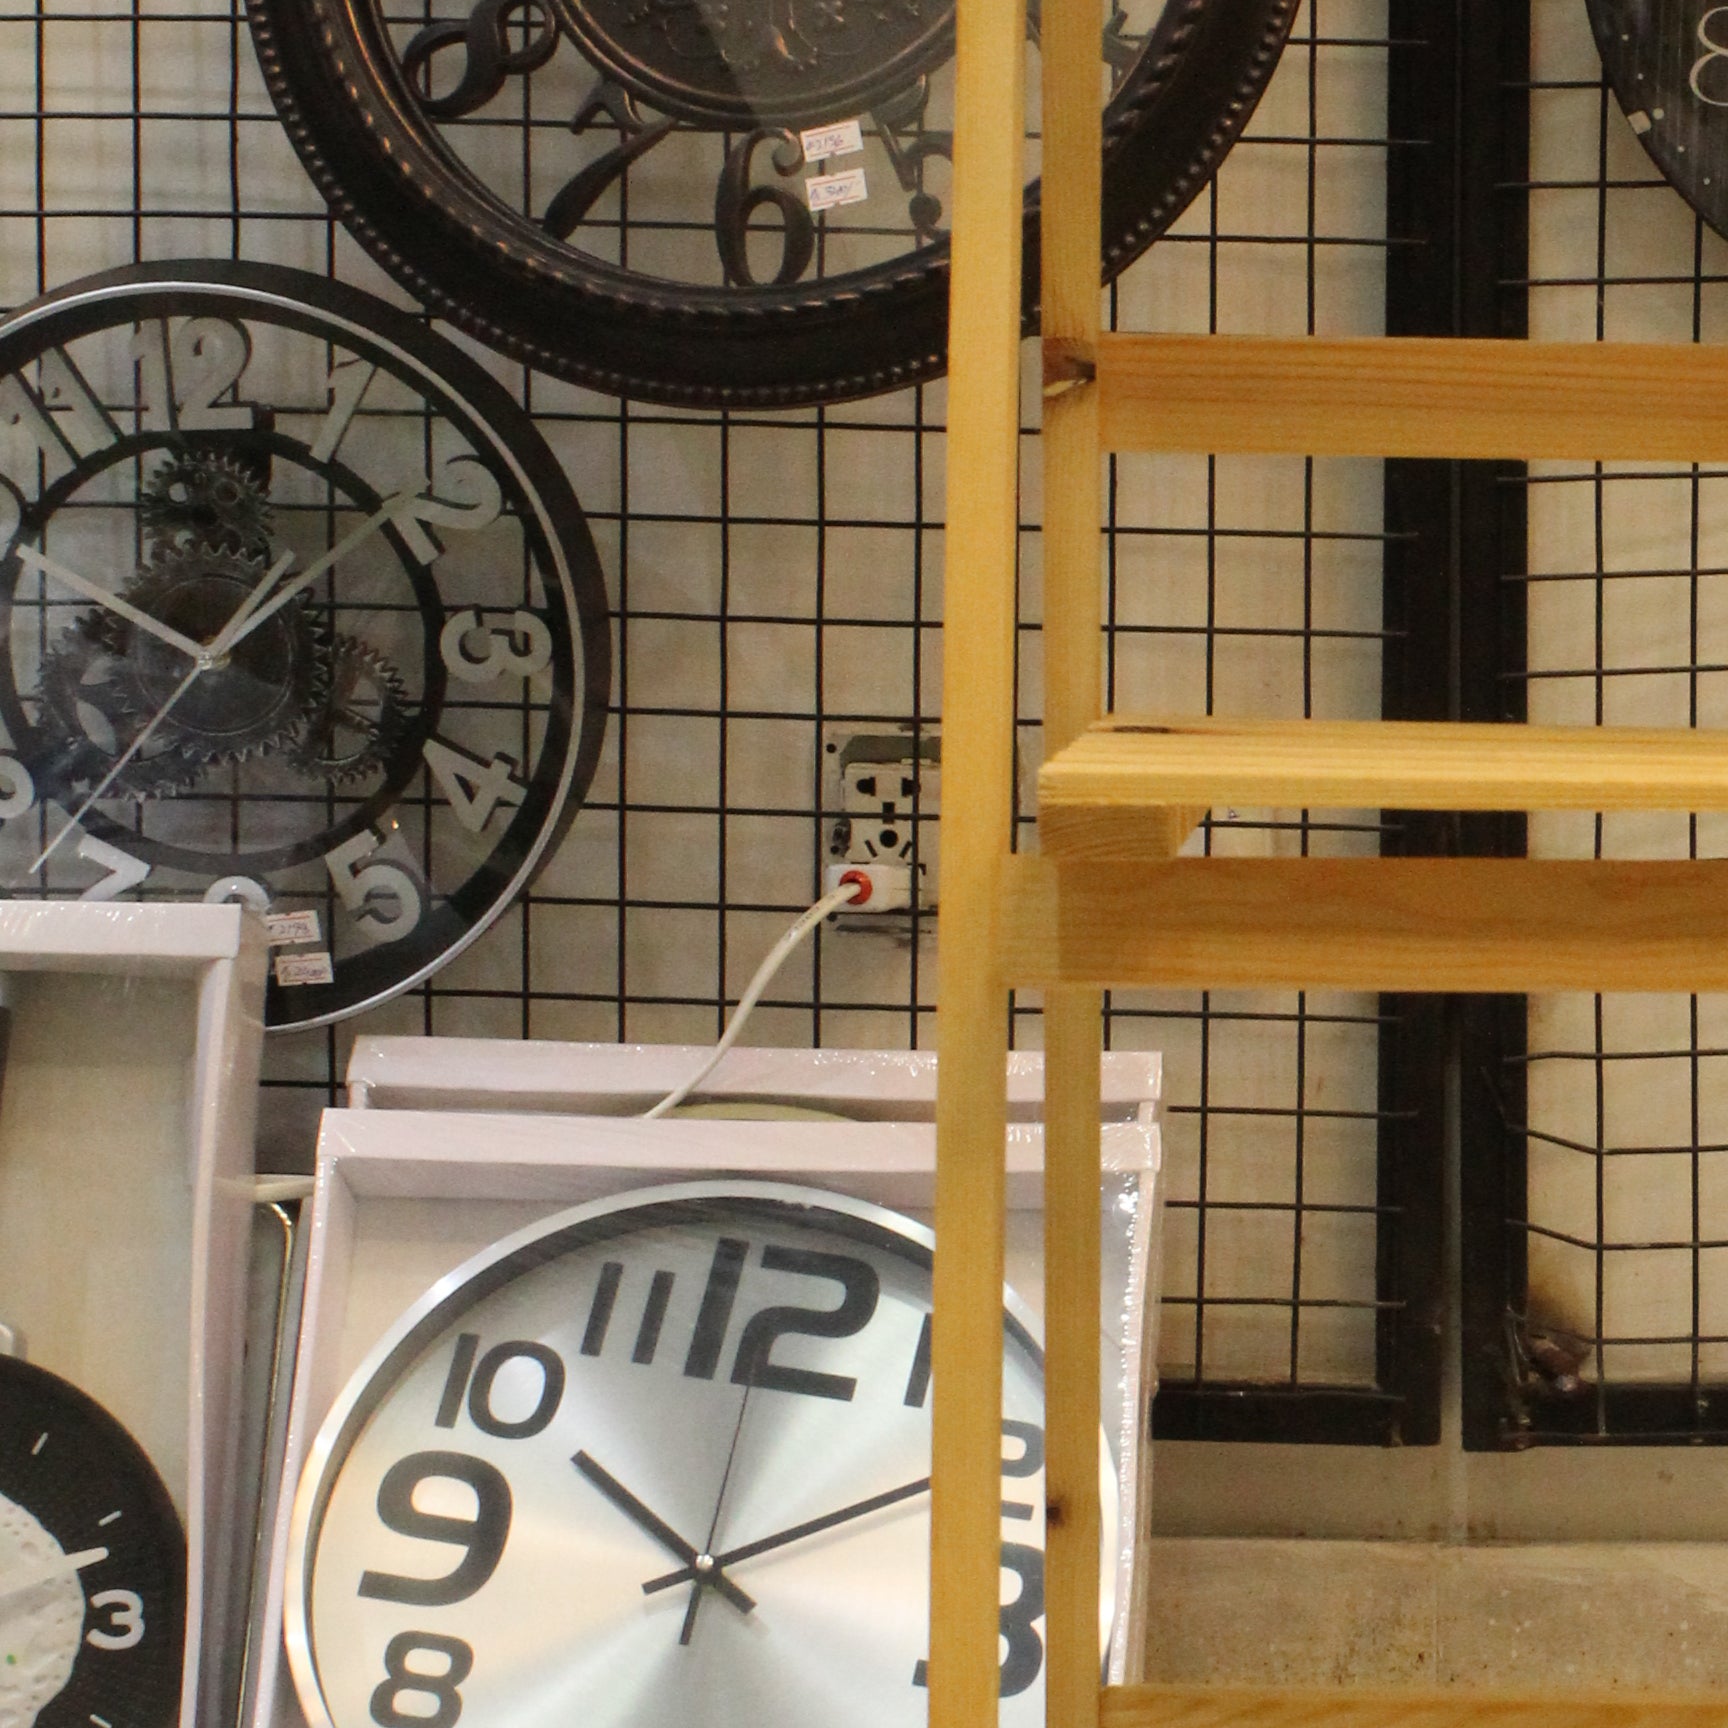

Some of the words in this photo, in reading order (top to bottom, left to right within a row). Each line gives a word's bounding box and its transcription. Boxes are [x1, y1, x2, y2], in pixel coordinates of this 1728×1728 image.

[542, 80, 680, 241] 7
[716, 125, 815, 286] 6
[131, 316, 256, 432] 12
[309, 355, 378, 463] 1
[378, 453, 502, 566] 2
[440, 608, 553, 684] 3
[422, 733, 531, 833] 4
[325, 827, 424, 944] 5
[580, 1261, 676, 1365] 11
[682, 1237, 880, 1402] 12
[434, 1333, 566, 1440] 10
[357, 1450, 513, 1608] 9
[86, 1588, 146, 1651] 3
